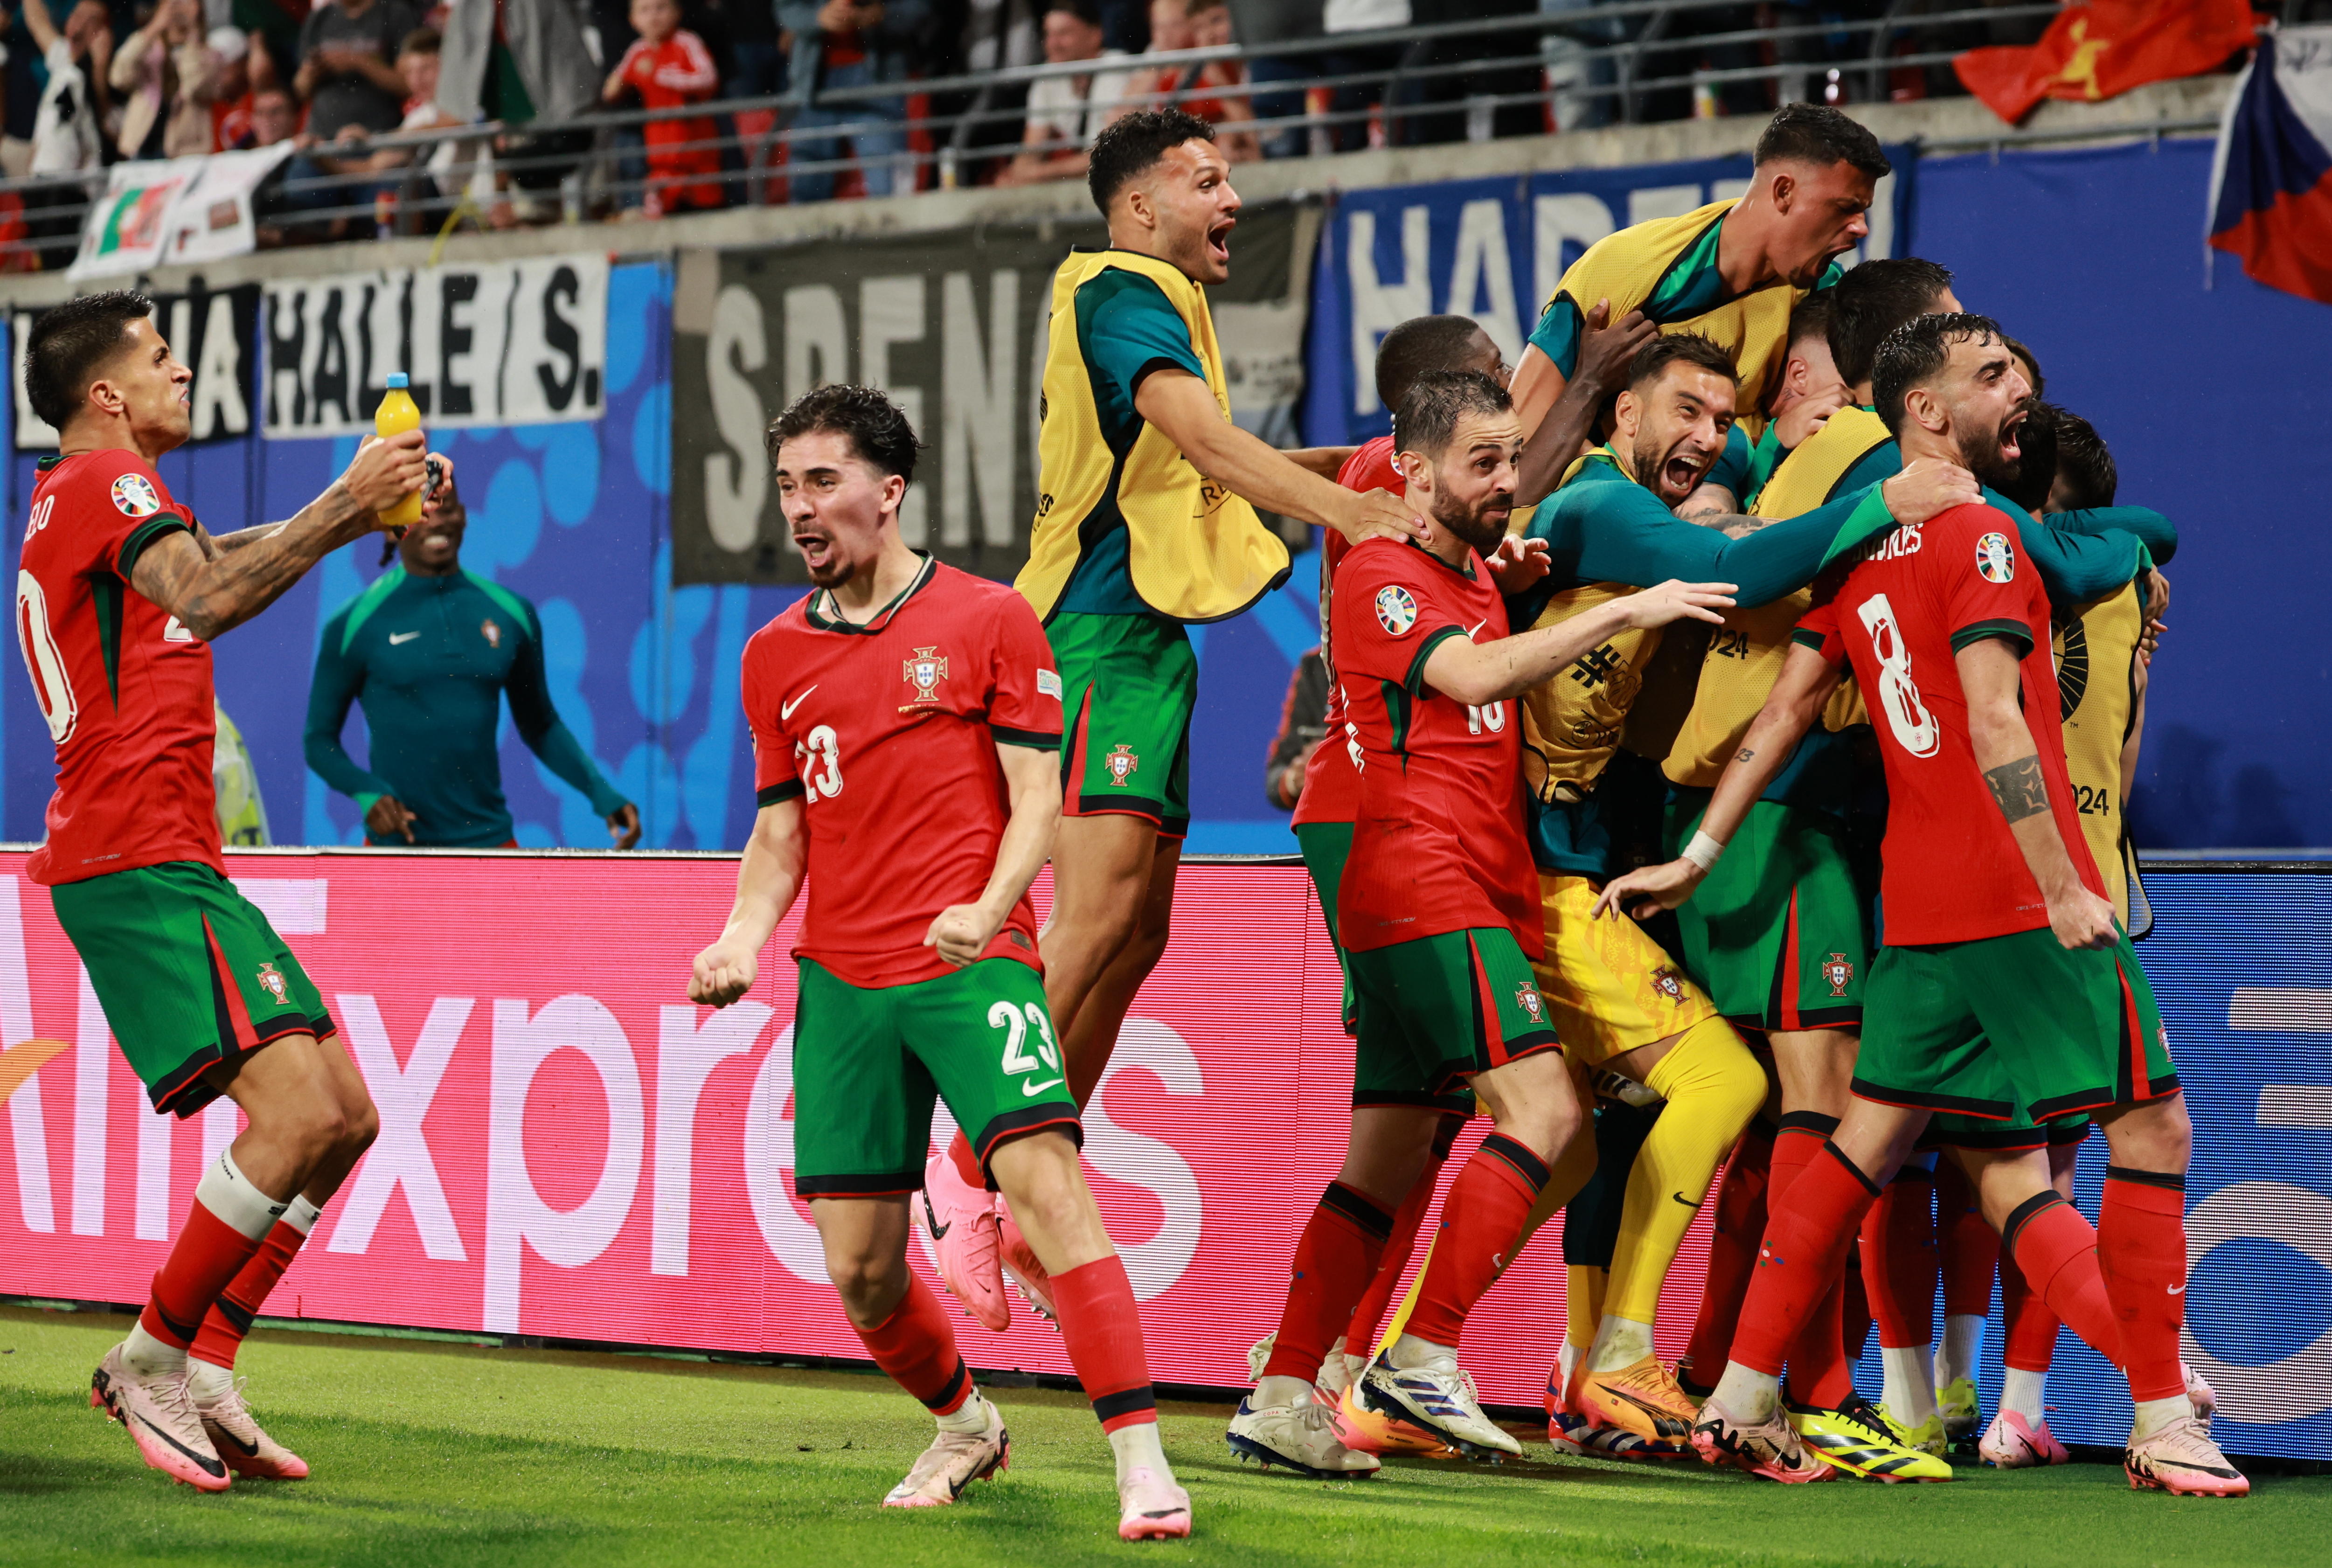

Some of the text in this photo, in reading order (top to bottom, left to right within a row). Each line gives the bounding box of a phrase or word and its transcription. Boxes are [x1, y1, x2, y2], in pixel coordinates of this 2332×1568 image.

[1857, 593, 1940, 758] 8
[795, 724, 844, 804] 23
[987, 1000, 1060, 1075] 23
